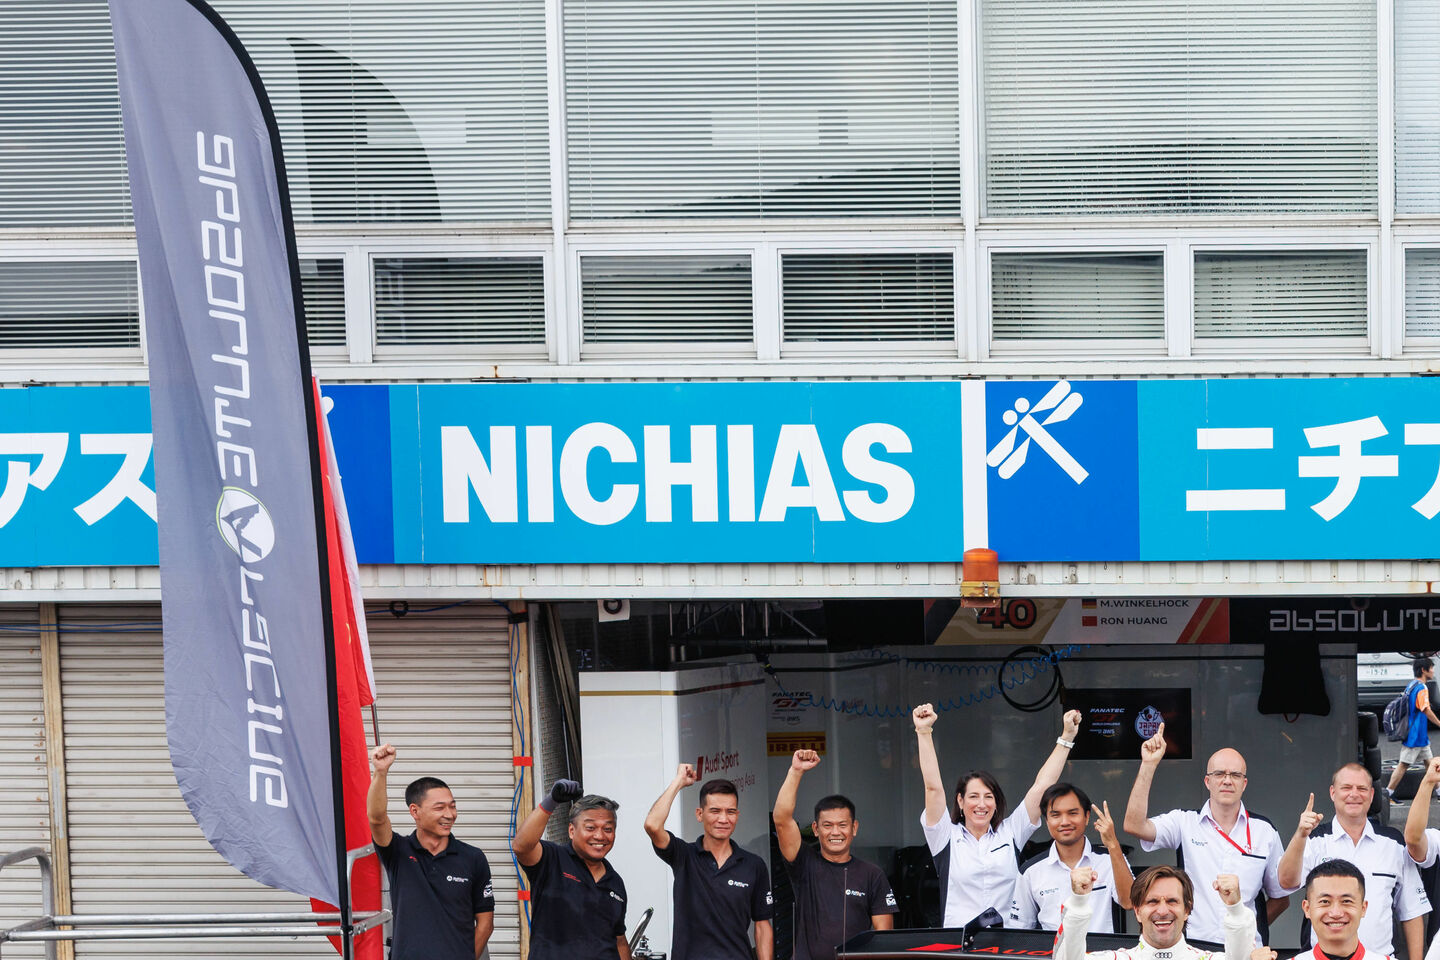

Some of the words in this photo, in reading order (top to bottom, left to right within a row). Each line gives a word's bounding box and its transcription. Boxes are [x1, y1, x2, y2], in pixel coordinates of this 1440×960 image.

[441, 420, 915, 525] NICHIAS
[977, 598, 1037, 630] 40
[1100, 617, 1123, 625] RON
[1127, 616, 1168, 625] HUANG
[704, 754, 719, 774] Audi
[721, 751, 739, 774] Sport
